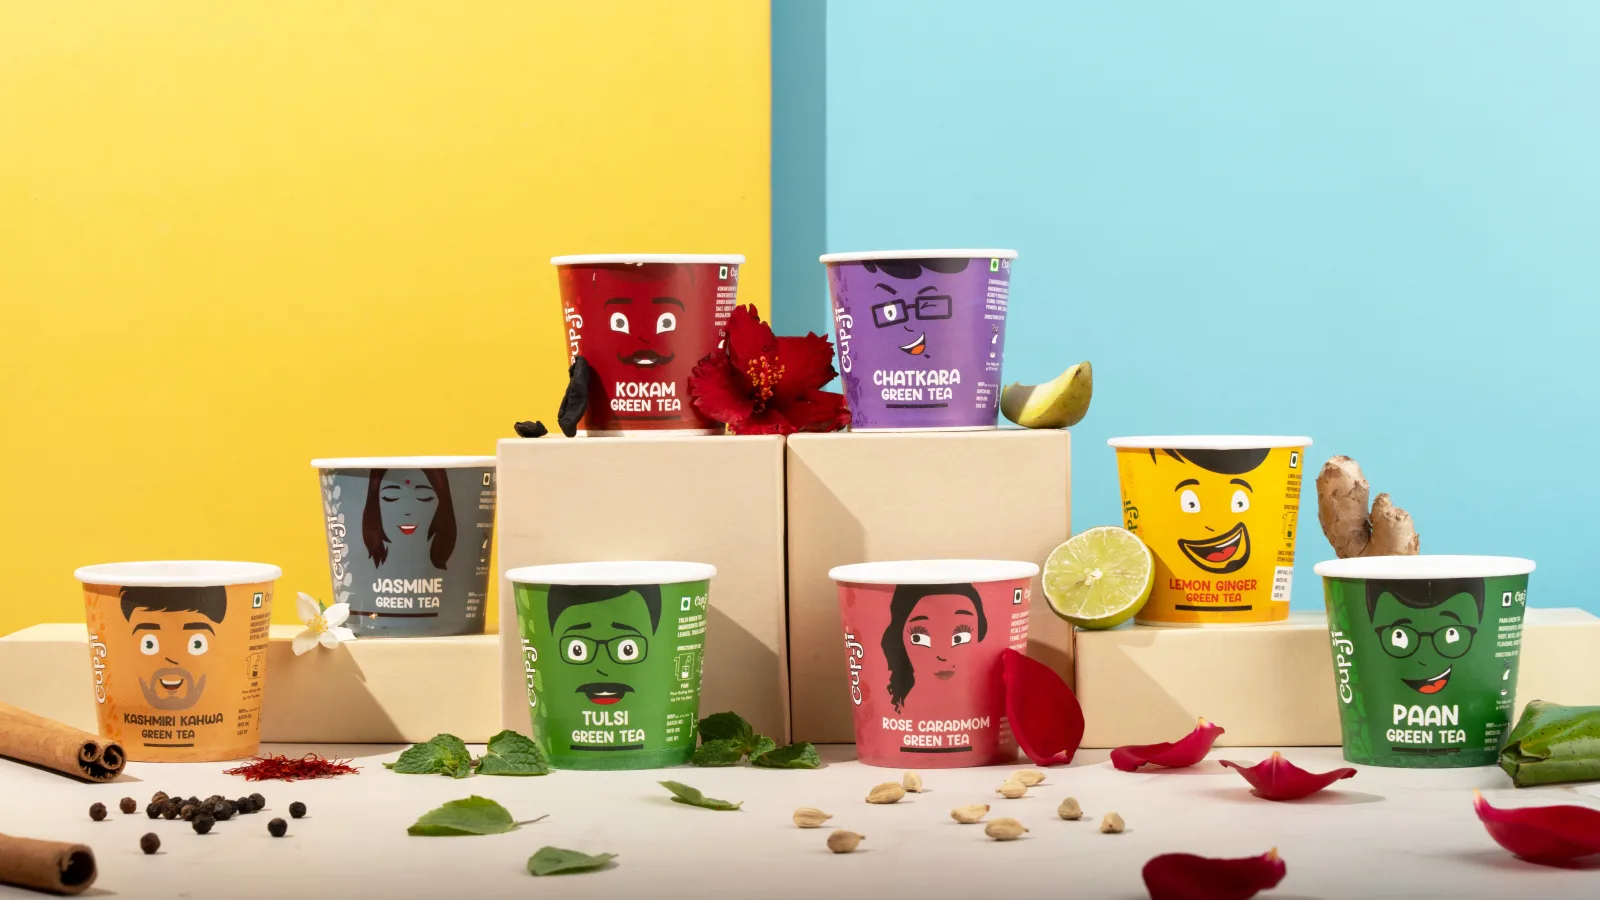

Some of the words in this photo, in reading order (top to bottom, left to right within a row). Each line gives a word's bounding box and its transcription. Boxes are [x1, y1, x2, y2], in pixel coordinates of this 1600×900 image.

[873, 369, 961, 387] CHATKARA
[615, 381, 676, 398] KOKAM
[881, 388, 922, 401] GREEN
[928, 387, 953, 400] TEA
[610, 398, 652, 412] GREEN
[656, 398, 681, 411] TEA
[372, 577, 443, 594] JASMINE
[1169, 578, 1211, 592] LEMON
[1215, 579, 1257, 592] GINGER
[375, 596, 413, 609] GREEN
[417, 596, 440, 608] TEA
[1186, 592, 1220, 603] GREEN
[1223, 592, 1242, 603] TEA
[123, 712, 176, 727] KASHMIRI
[180, 712, 224, 727] KAHWA
[581, 710, 629, 726] TULSI
[1393, 703, 1459, 727] PAAN
[882, 716, 913, 732] ROSE
[918, 716, 990, 733] CARADMOM
[141, 729, 173, 740] GREEN
[176, 729, 195, 739] TEA
[572, 729, 614, 743] GREEN
[619, 729, 645, 742] TEA
[903, 734, 942, 747] GREEN
[946, 734, 970, 746] TEA
[1386, 728, 1433, 744] GREEN
[1438, 729, 1466, 743] TEA
